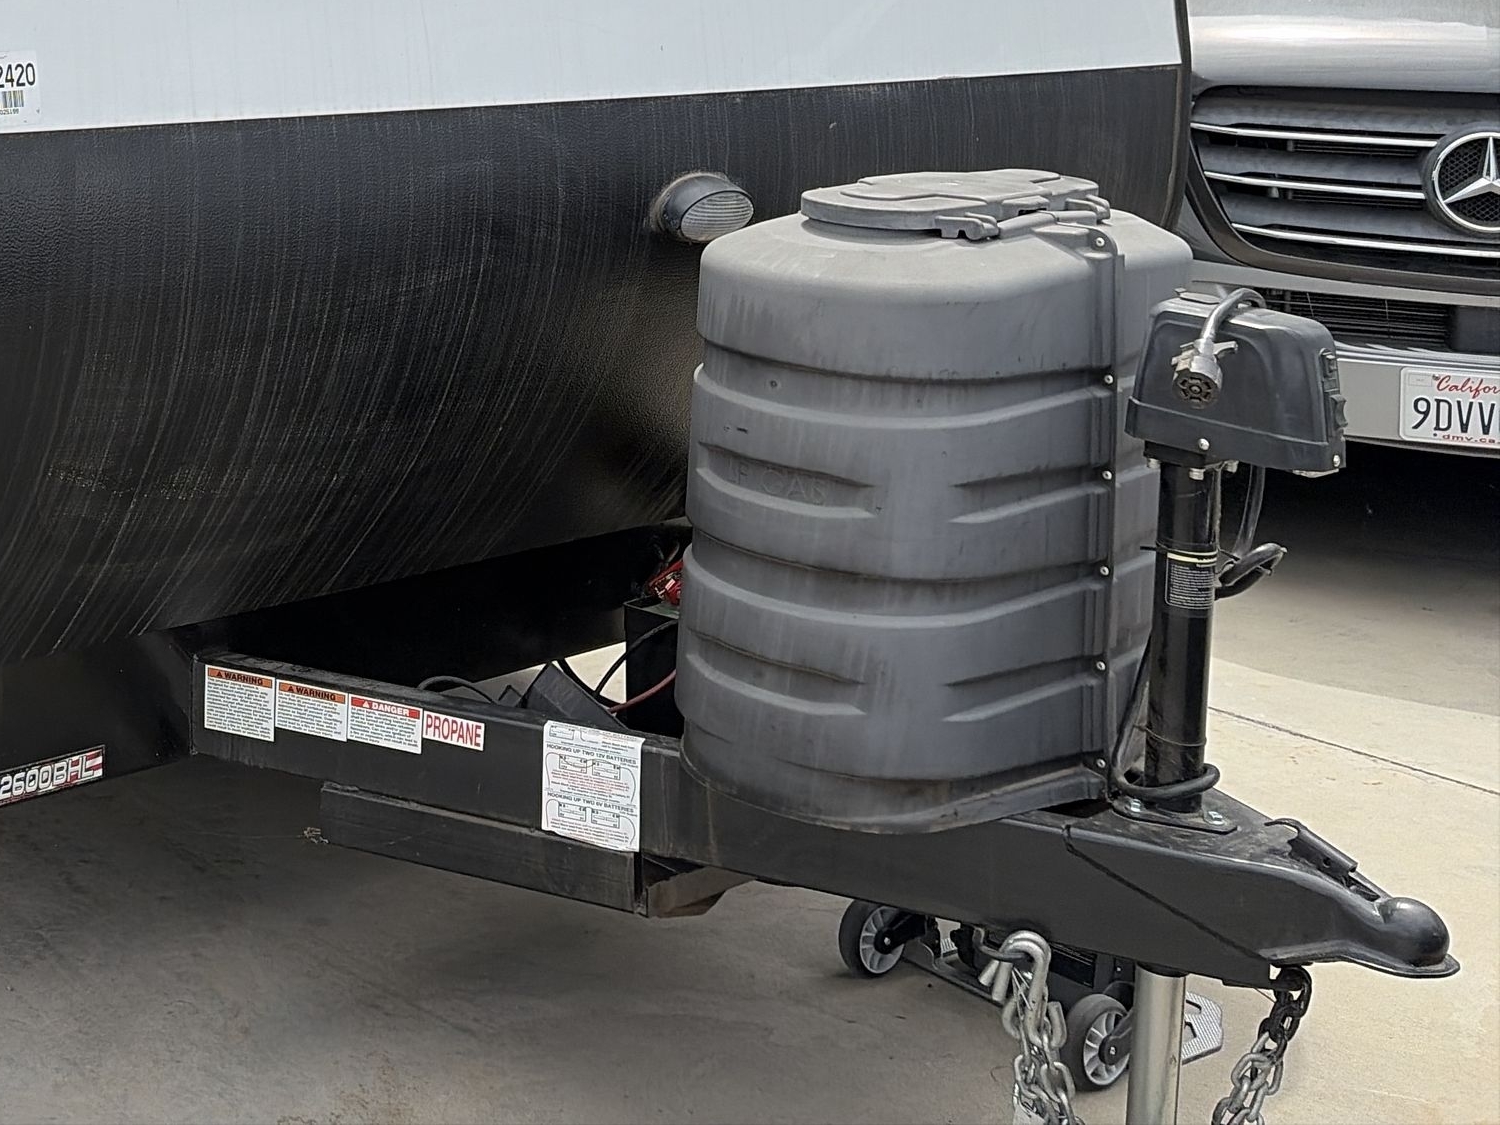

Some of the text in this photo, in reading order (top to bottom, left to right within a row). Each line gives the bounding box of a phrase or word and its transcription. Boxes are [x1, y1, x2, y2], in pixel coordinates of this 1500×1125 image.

[1412, 396, 1500, 435] 9DVV
[224, 672, 264, 686] WARNING
[295, 685, 337, 701] WARNING
[371, 703, 410, 717] DANGER
[425, 714, 482, 748] PROPANE
